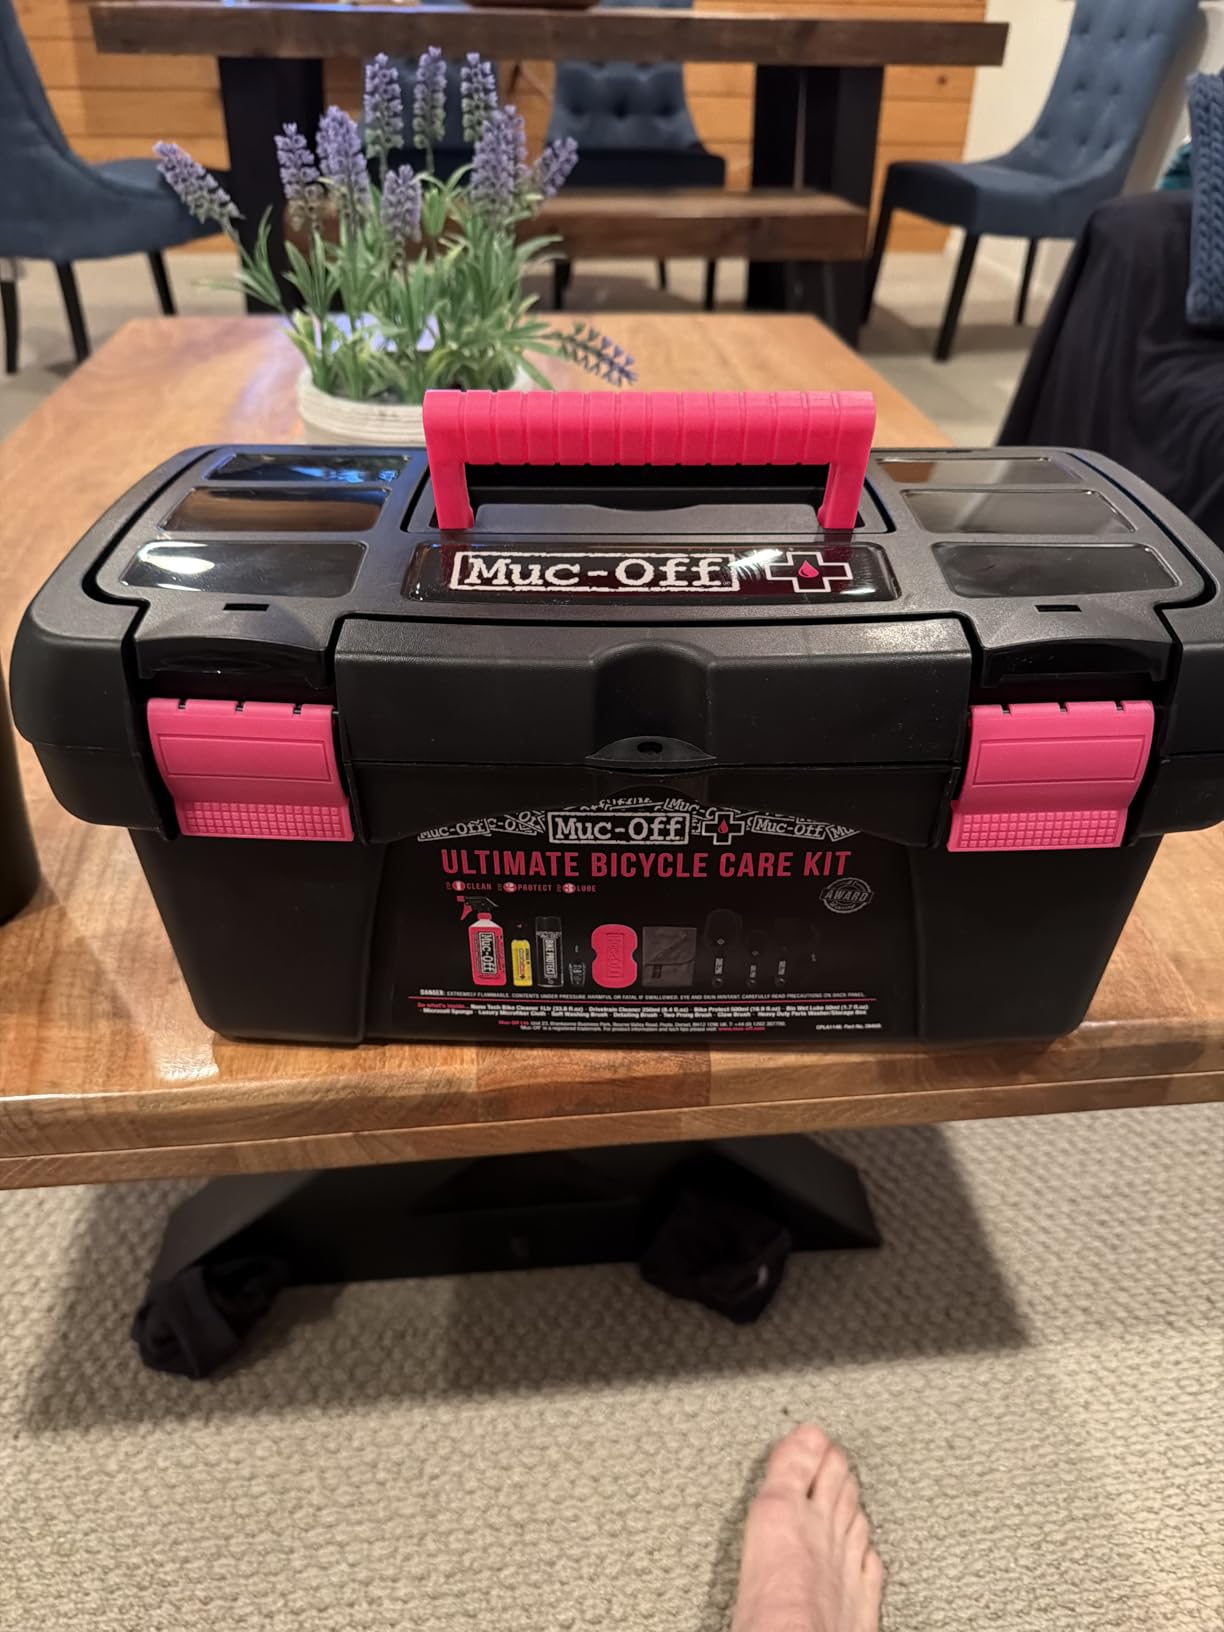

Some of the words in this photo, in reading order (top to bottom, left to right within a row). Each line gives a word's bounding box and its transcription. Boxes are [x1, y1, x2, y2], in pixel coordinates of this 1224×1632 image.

[463, 557, 725, 587] Muc-Off
[555, 817, 684, 841] Muc-Off
[755, 818, 825, 838] Muc-Off
[441, 849, 580, 877] ULTIMATE
[591, 852, 709, 878] BICYCLE
[719, 852, 794, 877] CARE
[803, 851, 852, 877] KIT
[466, 882, 492, 891] CLEAN
[517, 883, 552, 892] PROTECT
[824, 889, 869, 902] AWARD
[481, 933, 497, 974] Muc-Off
[545, 952, 556, 976] PROTECT
